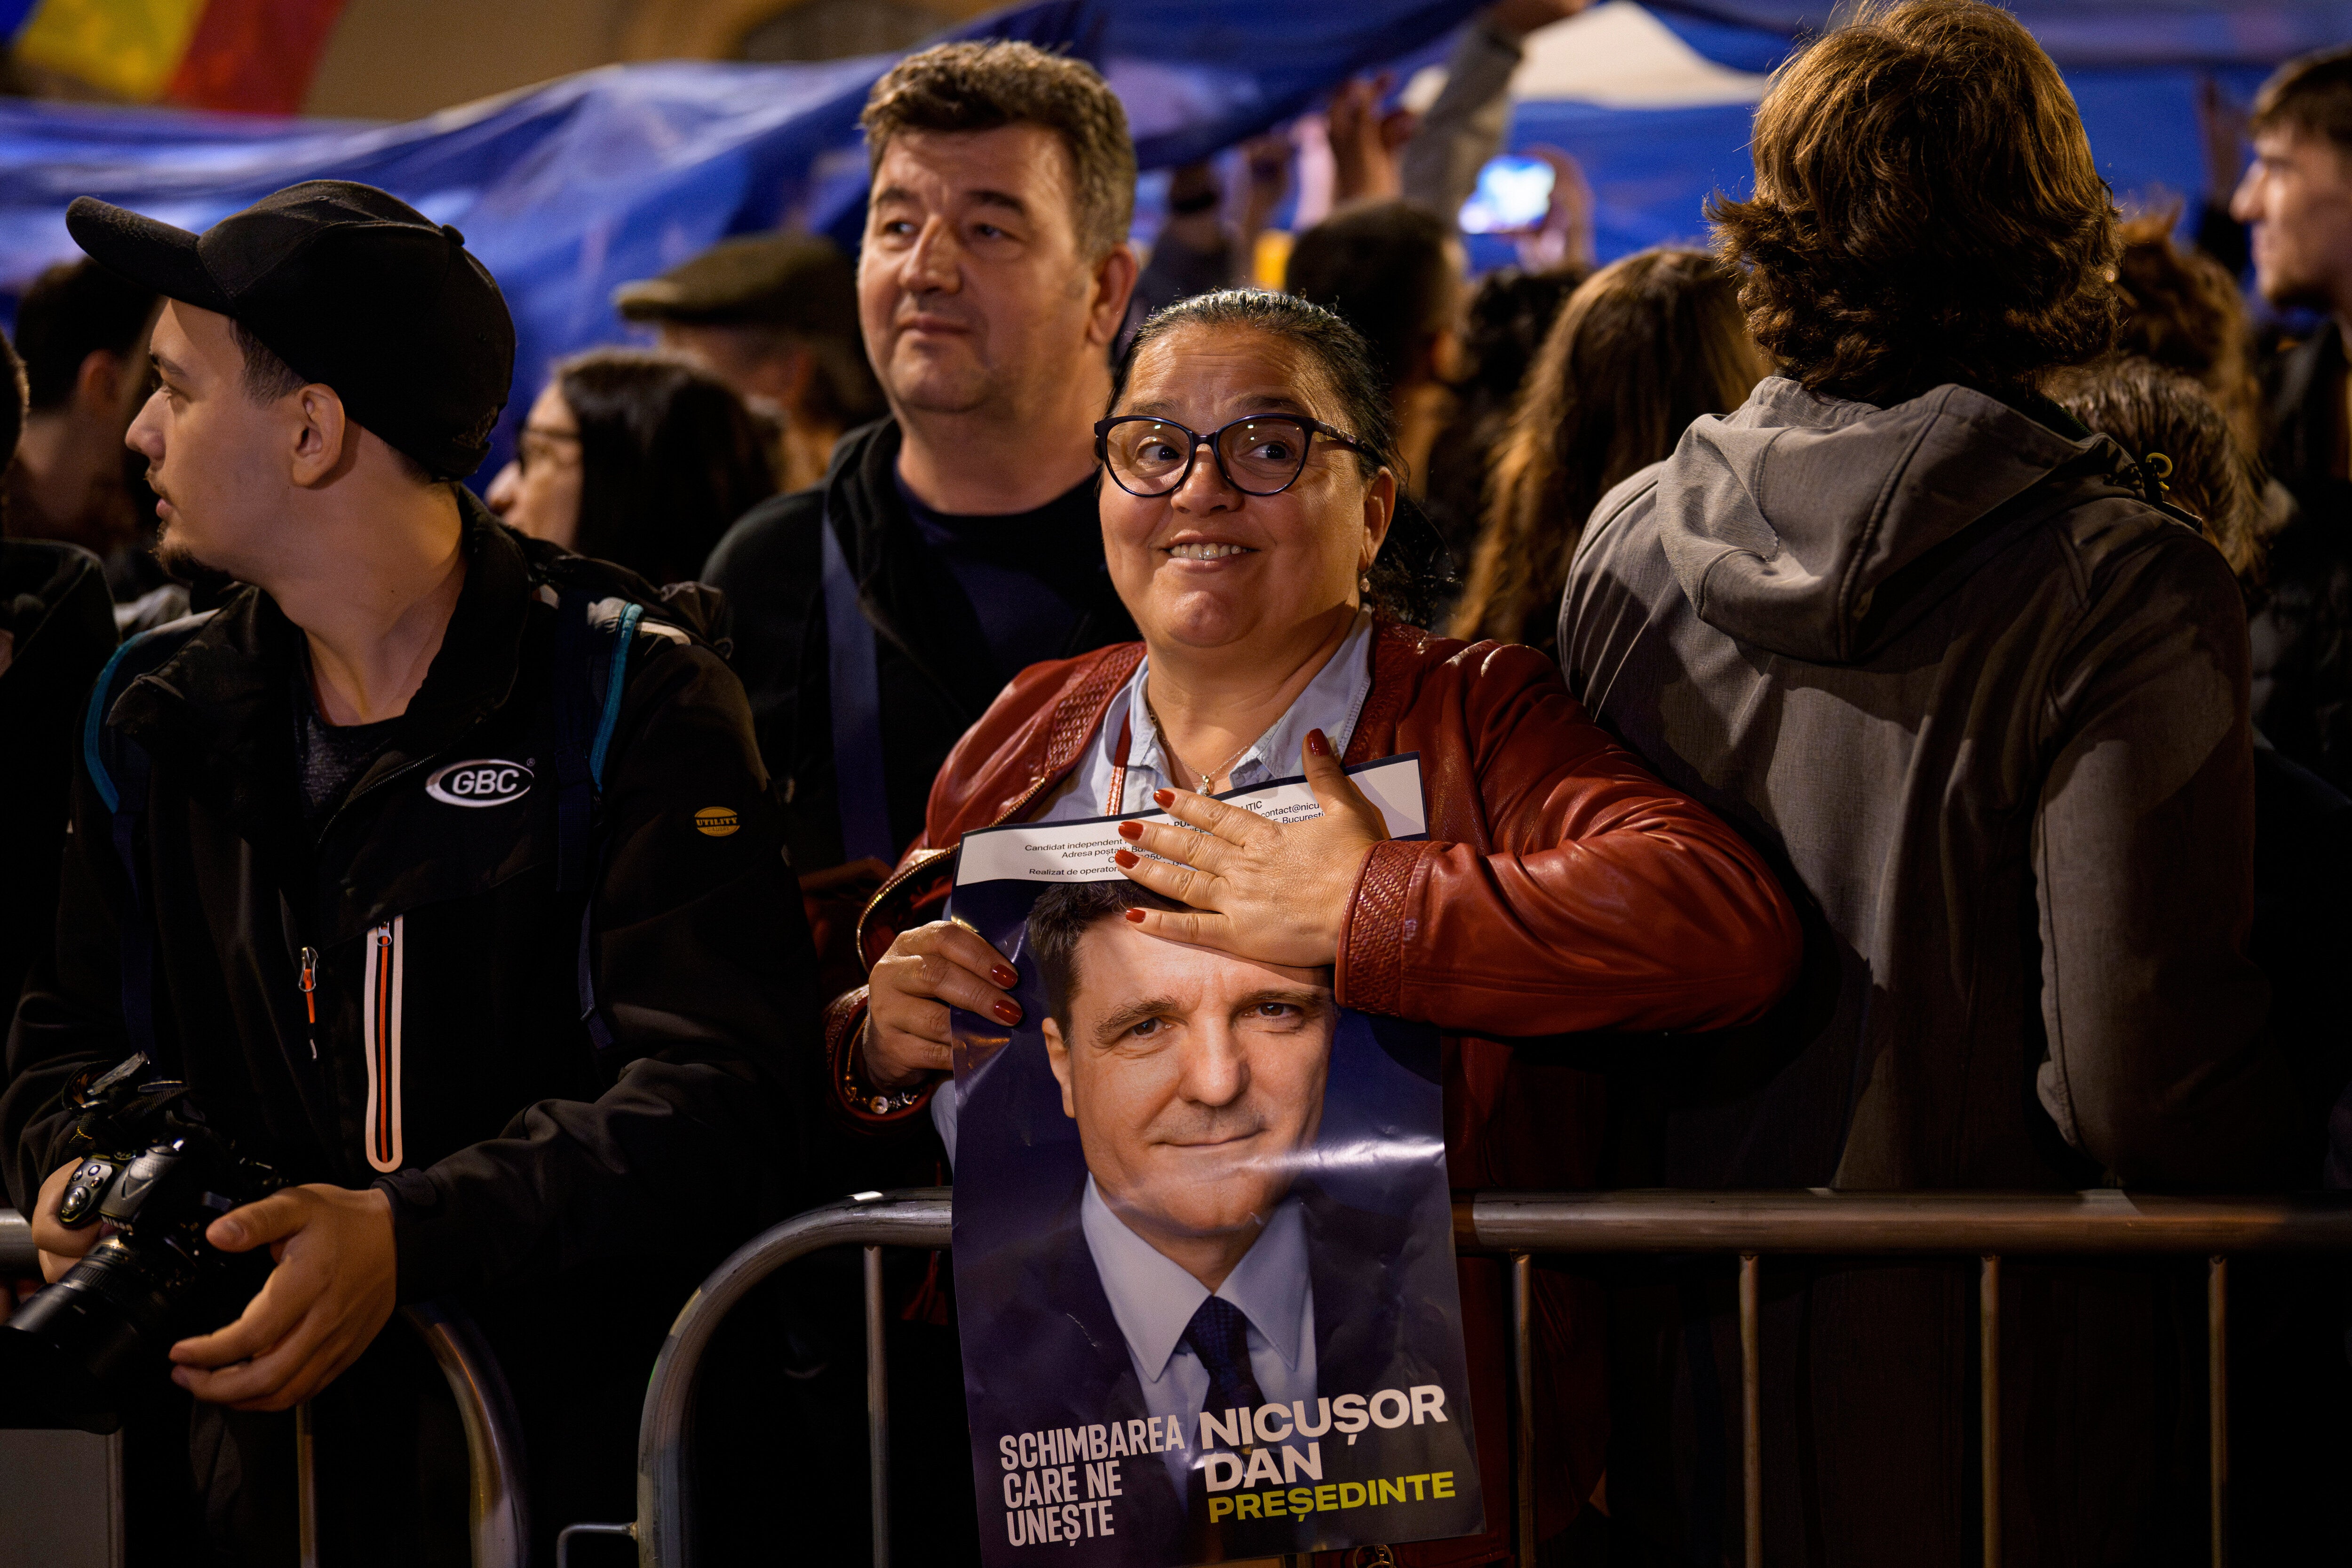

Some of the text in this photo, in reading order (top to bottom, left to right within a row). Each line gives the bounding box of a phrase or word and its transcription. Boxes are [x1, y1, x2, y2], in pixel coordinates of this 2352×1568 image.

[453, 769, 519, 794] GBC
[696, 817, 737, 826] UTILITY
[1067, 839, 1123, 849] independent
[1261, 802, 1319, 817] contact@nicu
[1062, 850, 1092, 858] Adresa
[1199, 1384, 1448, 1450] NICUȘOR
[1000, 1414, 1186, 1470] SCHIMBAREA
[1003, 1460, 1122, 1508] CARE NE
[1204, 1441, 1323, 1493] DAN
[1208, 1471, 1455, 1524] PREȘEDINTE
[1006, 1499, 1115, 1547] UNEȘTE
